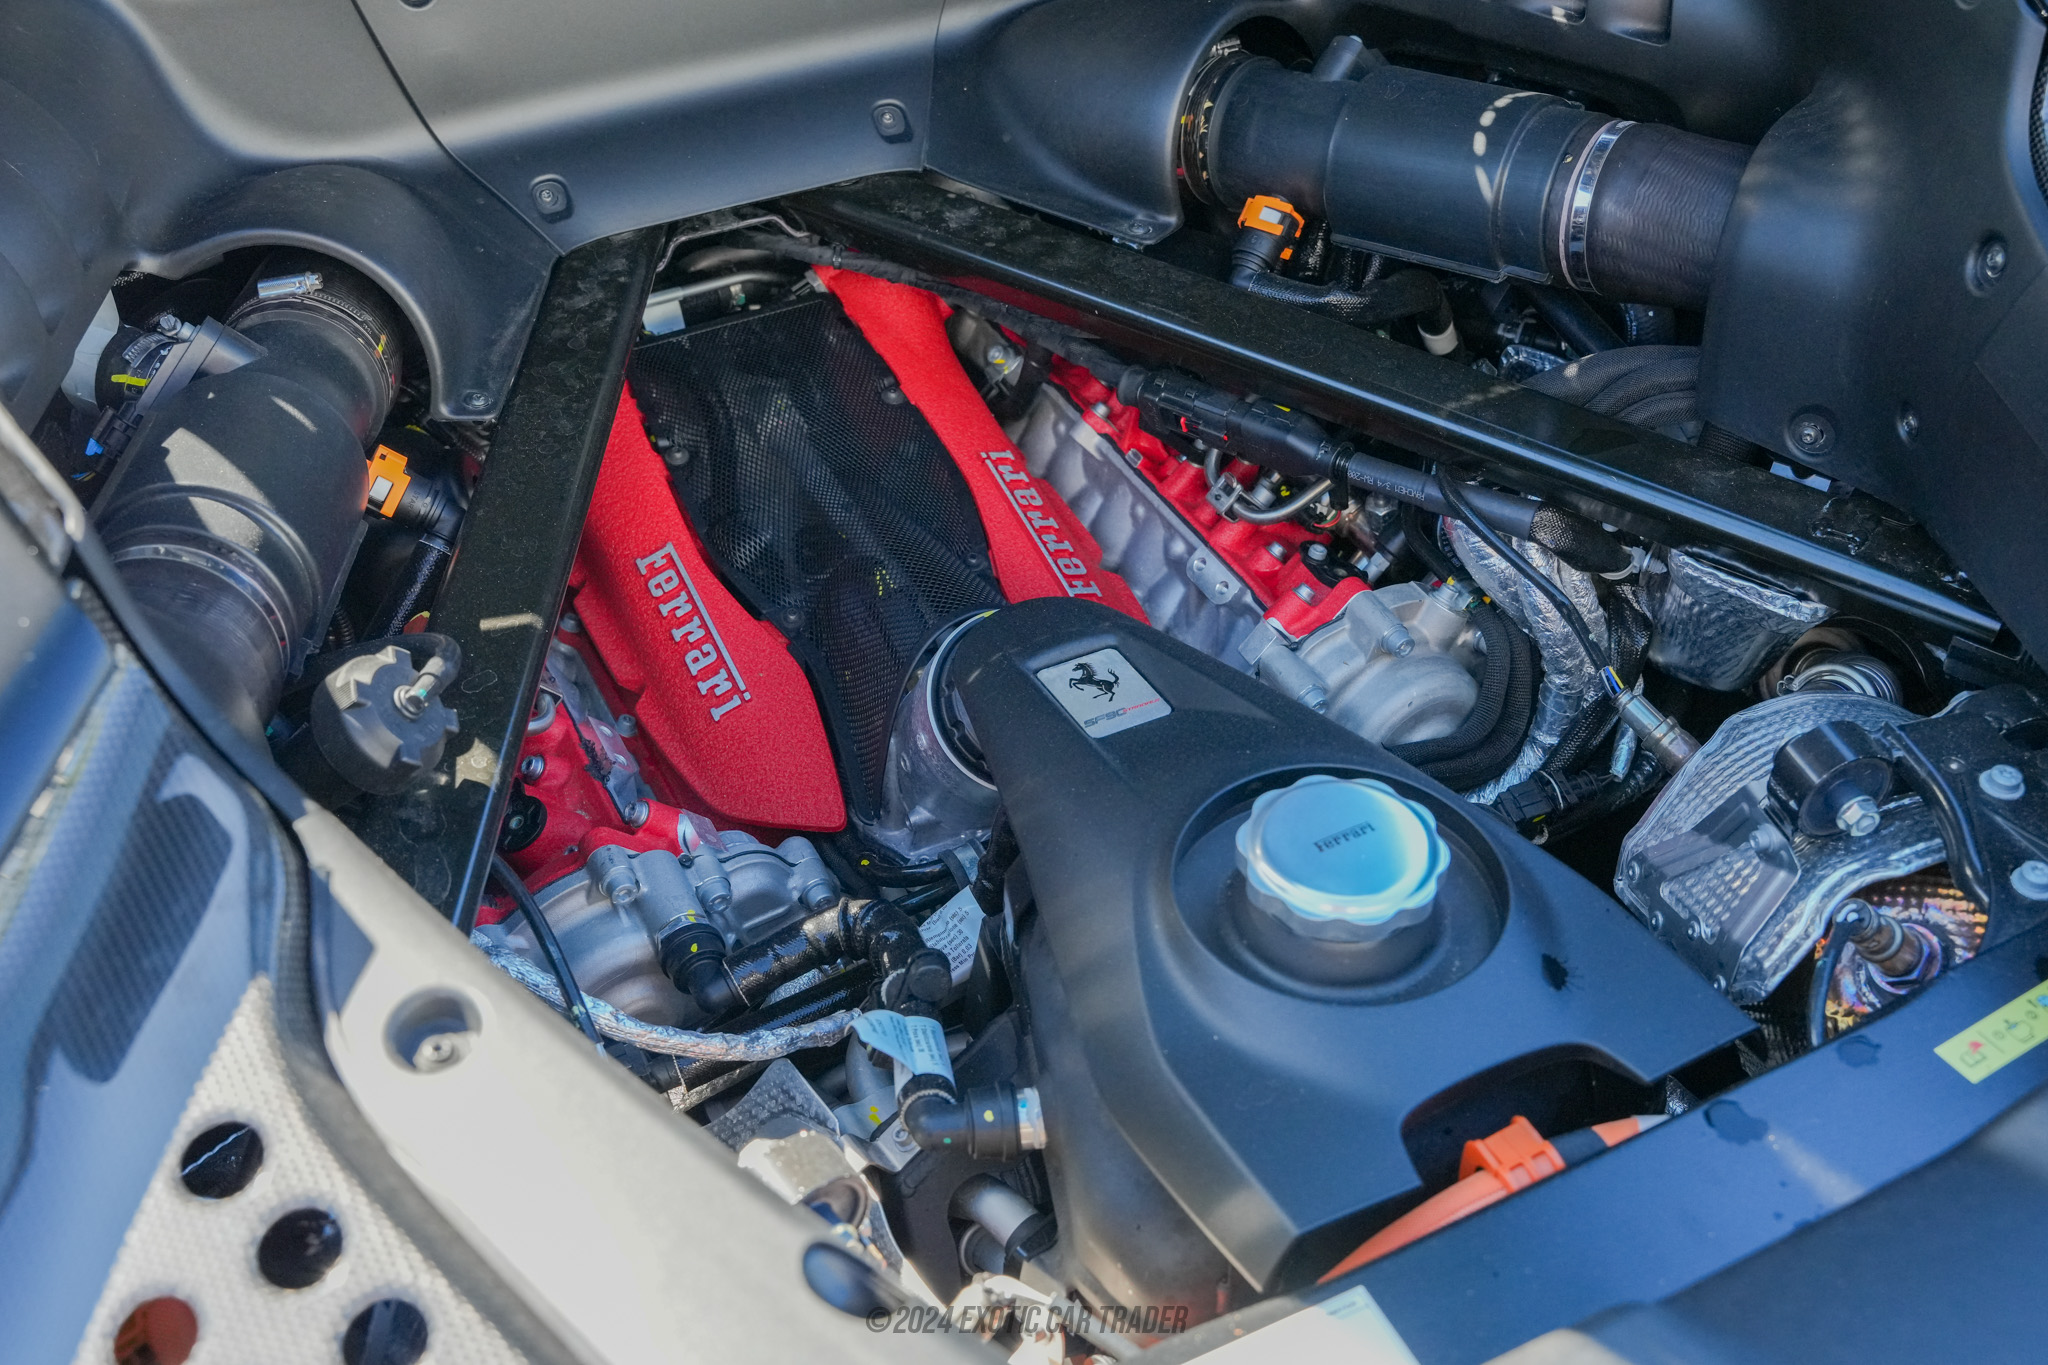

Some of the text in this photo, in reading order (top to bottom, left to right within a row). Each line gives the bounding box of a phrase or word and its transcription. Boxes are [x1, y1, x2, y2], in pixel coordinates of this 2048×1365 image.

[980, 450, 1103, 597] Ferrari
[1377, 479, 1392, 491] 3/4
[635, 541, 752, 722] Ferrari
[1313, 820, 1376, 853] Ferrari
